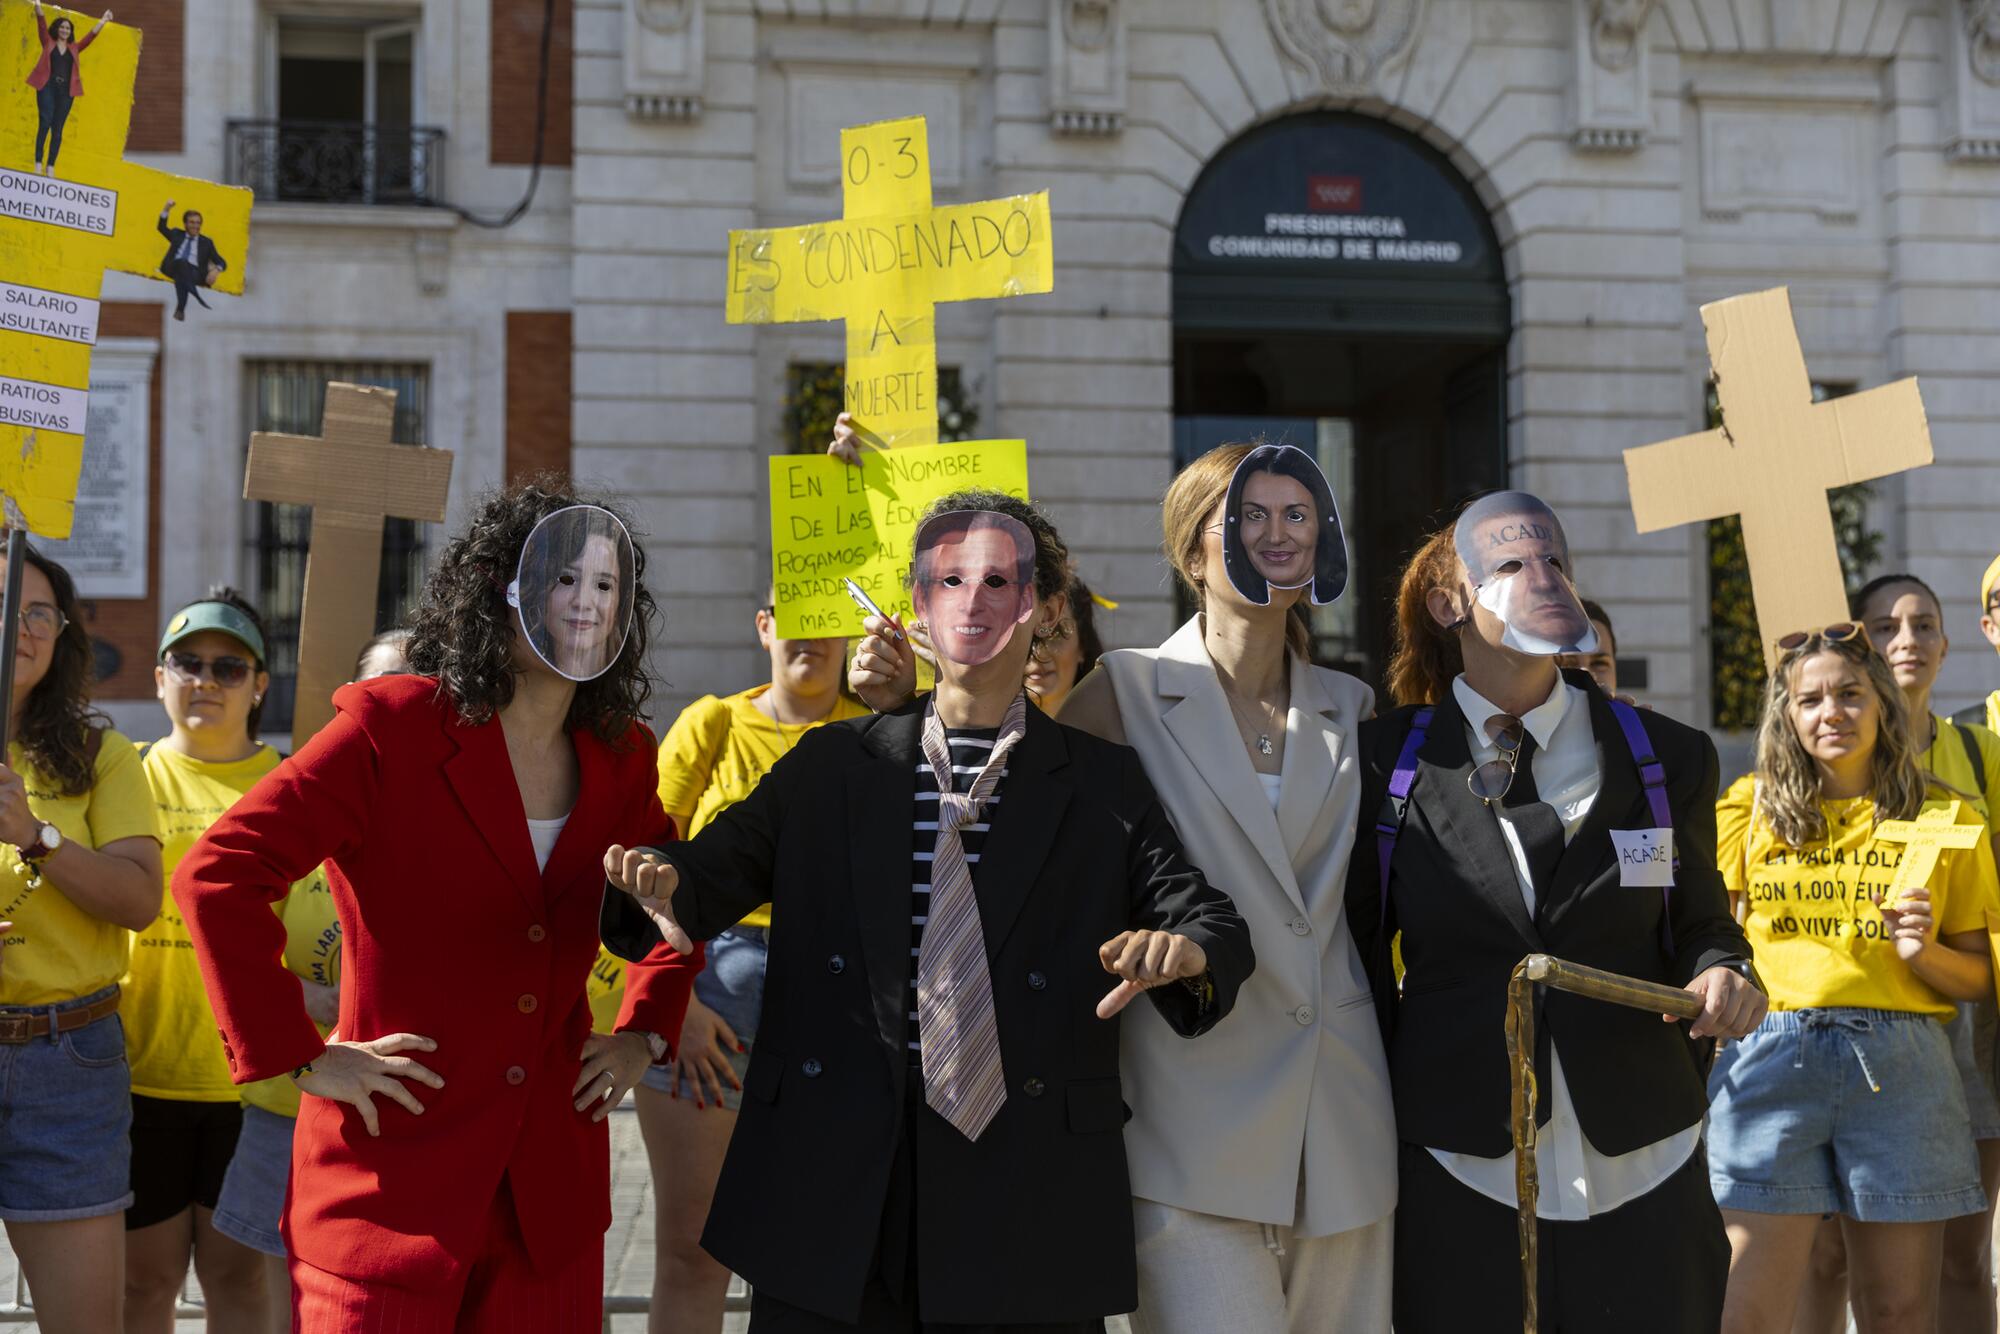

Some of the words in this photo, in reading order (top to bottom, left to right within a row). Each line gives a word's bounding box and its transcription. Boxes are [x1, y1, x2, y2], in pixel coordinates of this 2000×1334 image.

[0, 174, 111, 209] ONDICIONES
[0, 198, 106, 231] AMENTABLES
[1265, 213, 1406, 237] PRESIDENCIA
[733, 241, 782, 293] ES
[804, 209, 1031, 289] CONDENADO
[1208, 235, 1340, 259] COMUNIDAD
[1342, 239, 1373, 260] DE
[1376, 240, 1462, 262] MADRID
[6, 289, 78, 315] SALARIO
[0, 312, 90, 340] NSULTANTE
[871, 309, 901, 352] A
[1, 382, 61, 405] RATIOS
[845, 371, 928, 417] MUERTE
[0, 406, 69, 429] BUSIVAS
[777, 546, 868, 575] ROGAMOS
[1623, 845, 1667, 865] ACADE
[1765, 849, 1787, 866] LA
[1796, 847, 1845, 866] VACA
[1754, 881, 1786, 901] CON
[1793, 880, 1846, 900] 1.000
[1771, 916, 1799, 935] NO
[1800, 917, 1842, 937] VIVE
[1854, 918, 1891, 941] SOL
